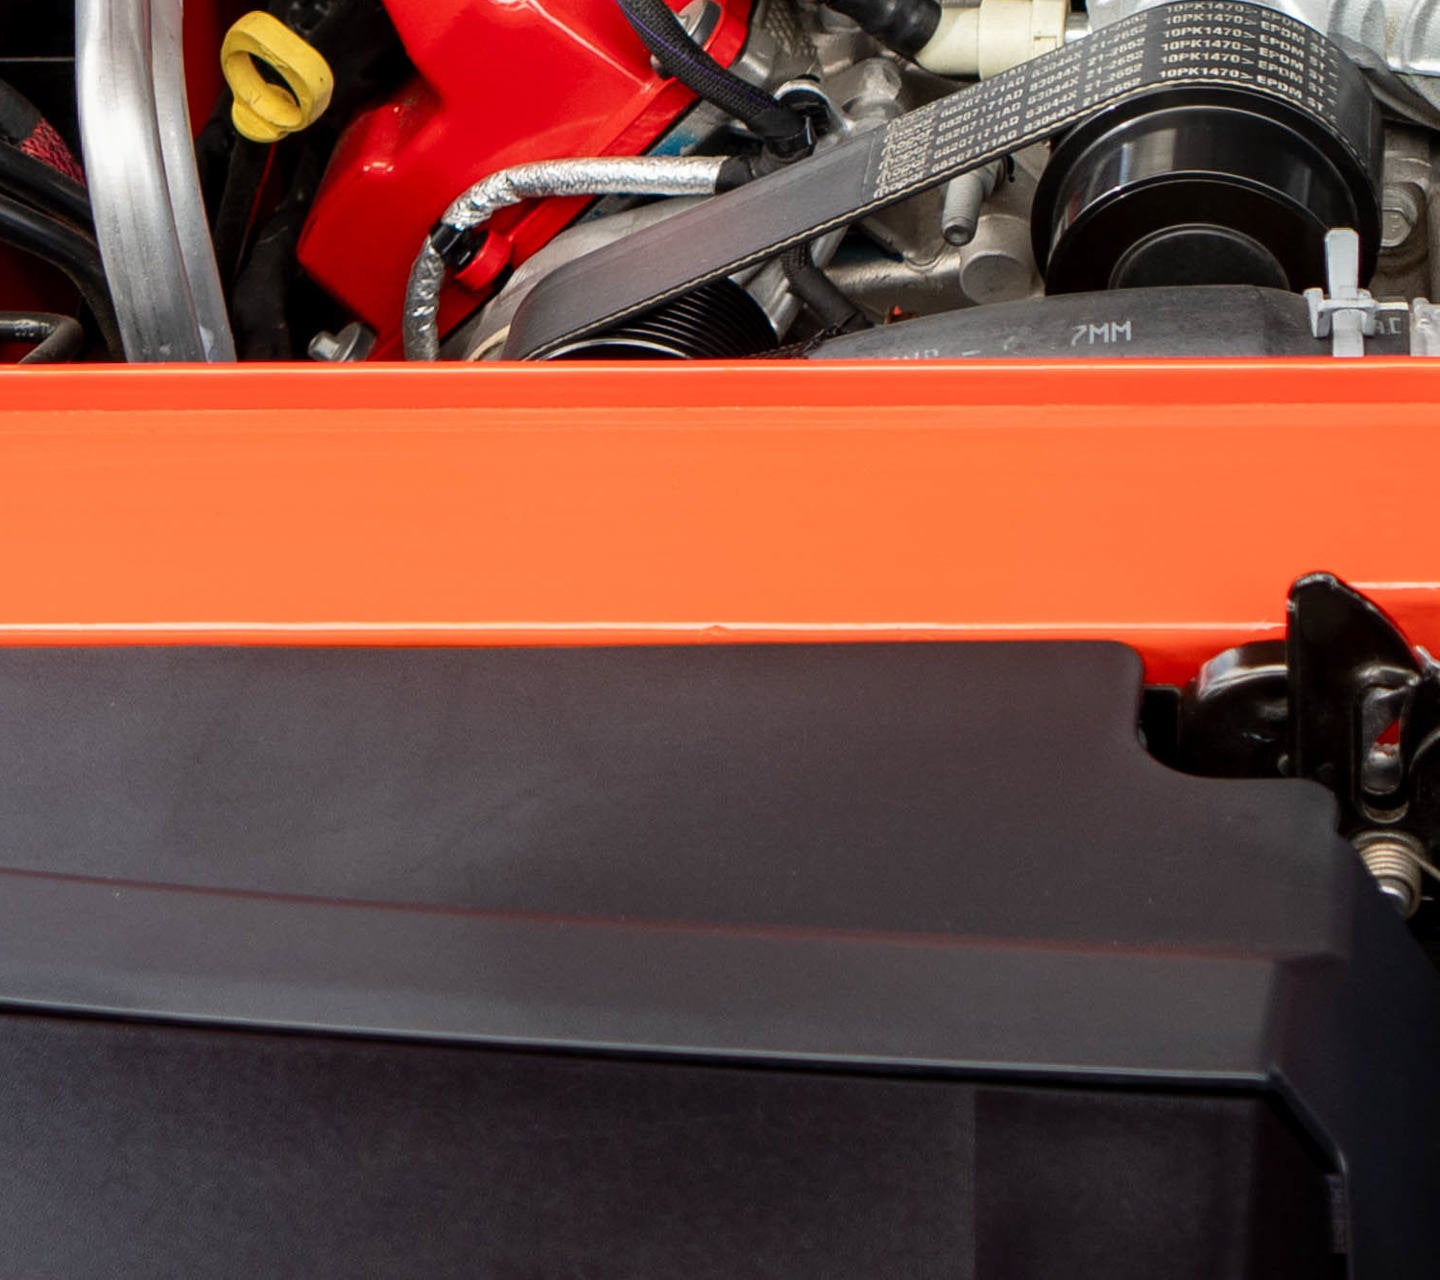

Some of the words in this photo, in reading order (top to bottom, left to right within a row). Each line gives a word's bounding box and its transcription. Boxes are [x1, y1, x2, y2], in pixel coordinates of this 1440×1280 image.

[1260, 21, 1305, 46] EPDM
[1258, 46, 1304, 72] EPDM
[1257, 60, 1304, 85] EPDM
[1256, 74, 1303, 100] EPDM
[1307, 96, 1324, 113] ST
[1070, 320, 1132, 346] 7MM
